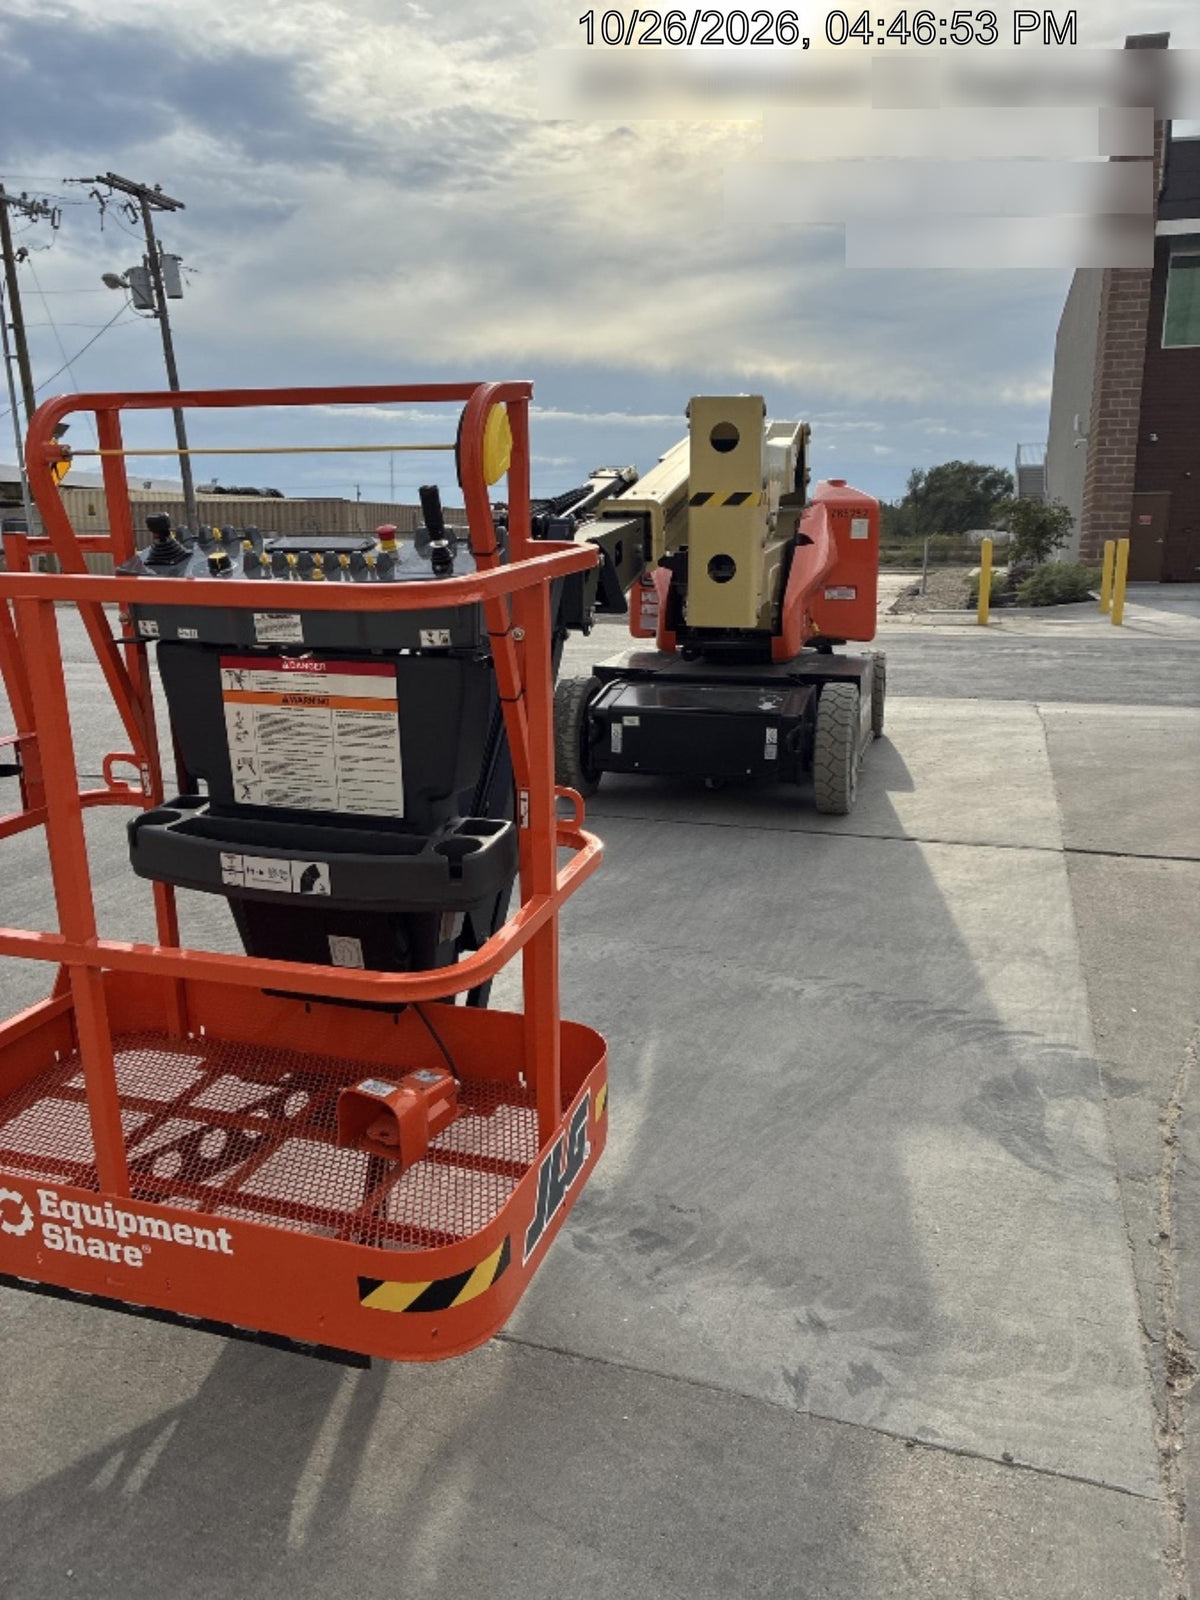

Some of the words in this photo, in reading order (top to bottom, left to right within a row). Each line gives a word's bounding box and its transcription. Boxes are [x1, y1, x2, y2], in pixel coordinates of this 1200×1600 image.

[289, 661, 327, 671] DANGER
[290, 695, 330, 707] WARNING
[522, 1086, 591, 1268] JLG
[37, 1188, 234, 1255] Equipment
